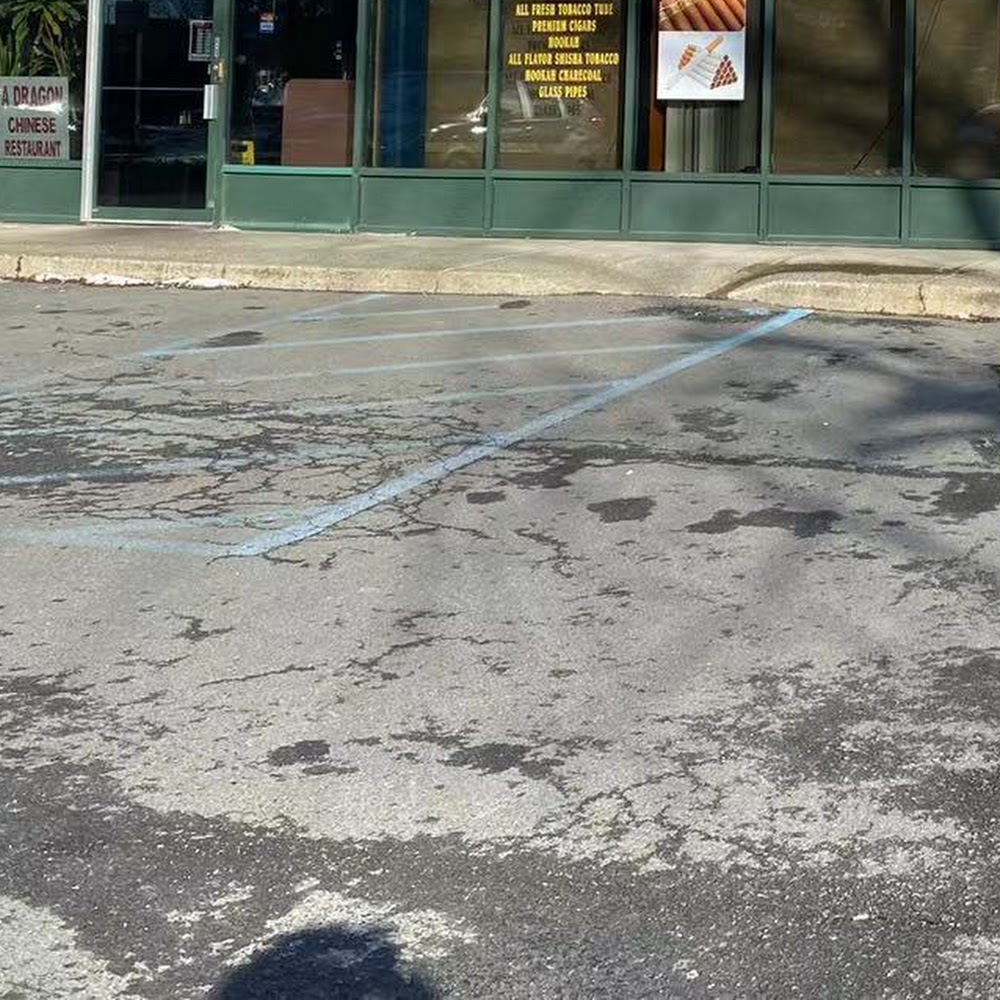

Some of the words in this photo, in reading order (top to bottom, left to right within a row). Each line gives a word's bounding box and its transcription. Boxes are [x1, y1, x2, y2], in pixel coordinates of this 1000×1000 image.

[515, 4, 529, 16] ALL
[531, 3, 556, 15] FRESH
[558, 3, 592, 15] TOBACCO
[532, 20, 567, 32] PREMIUM
[569, 20, 597, 32] CIGARS
[548, 36, 580, 48] HOOKAH
[508, 53, 522, 65] ALL
[524, 53, 552, 65] FLAVOR
[554, 53, 583, 65] SHISHA
[585, 53, 619, 65] TOBACCO
[525, 69, 557, 81] HOOKAH
[13, 85, 63, 106] DRAGON
[539, 86, 562, 98] GLASS
[565, 86, 587, 98] PIPES
[8, 117, 56, 133] CHINESE
[4, 140, 61, 157] RESTAURANT
